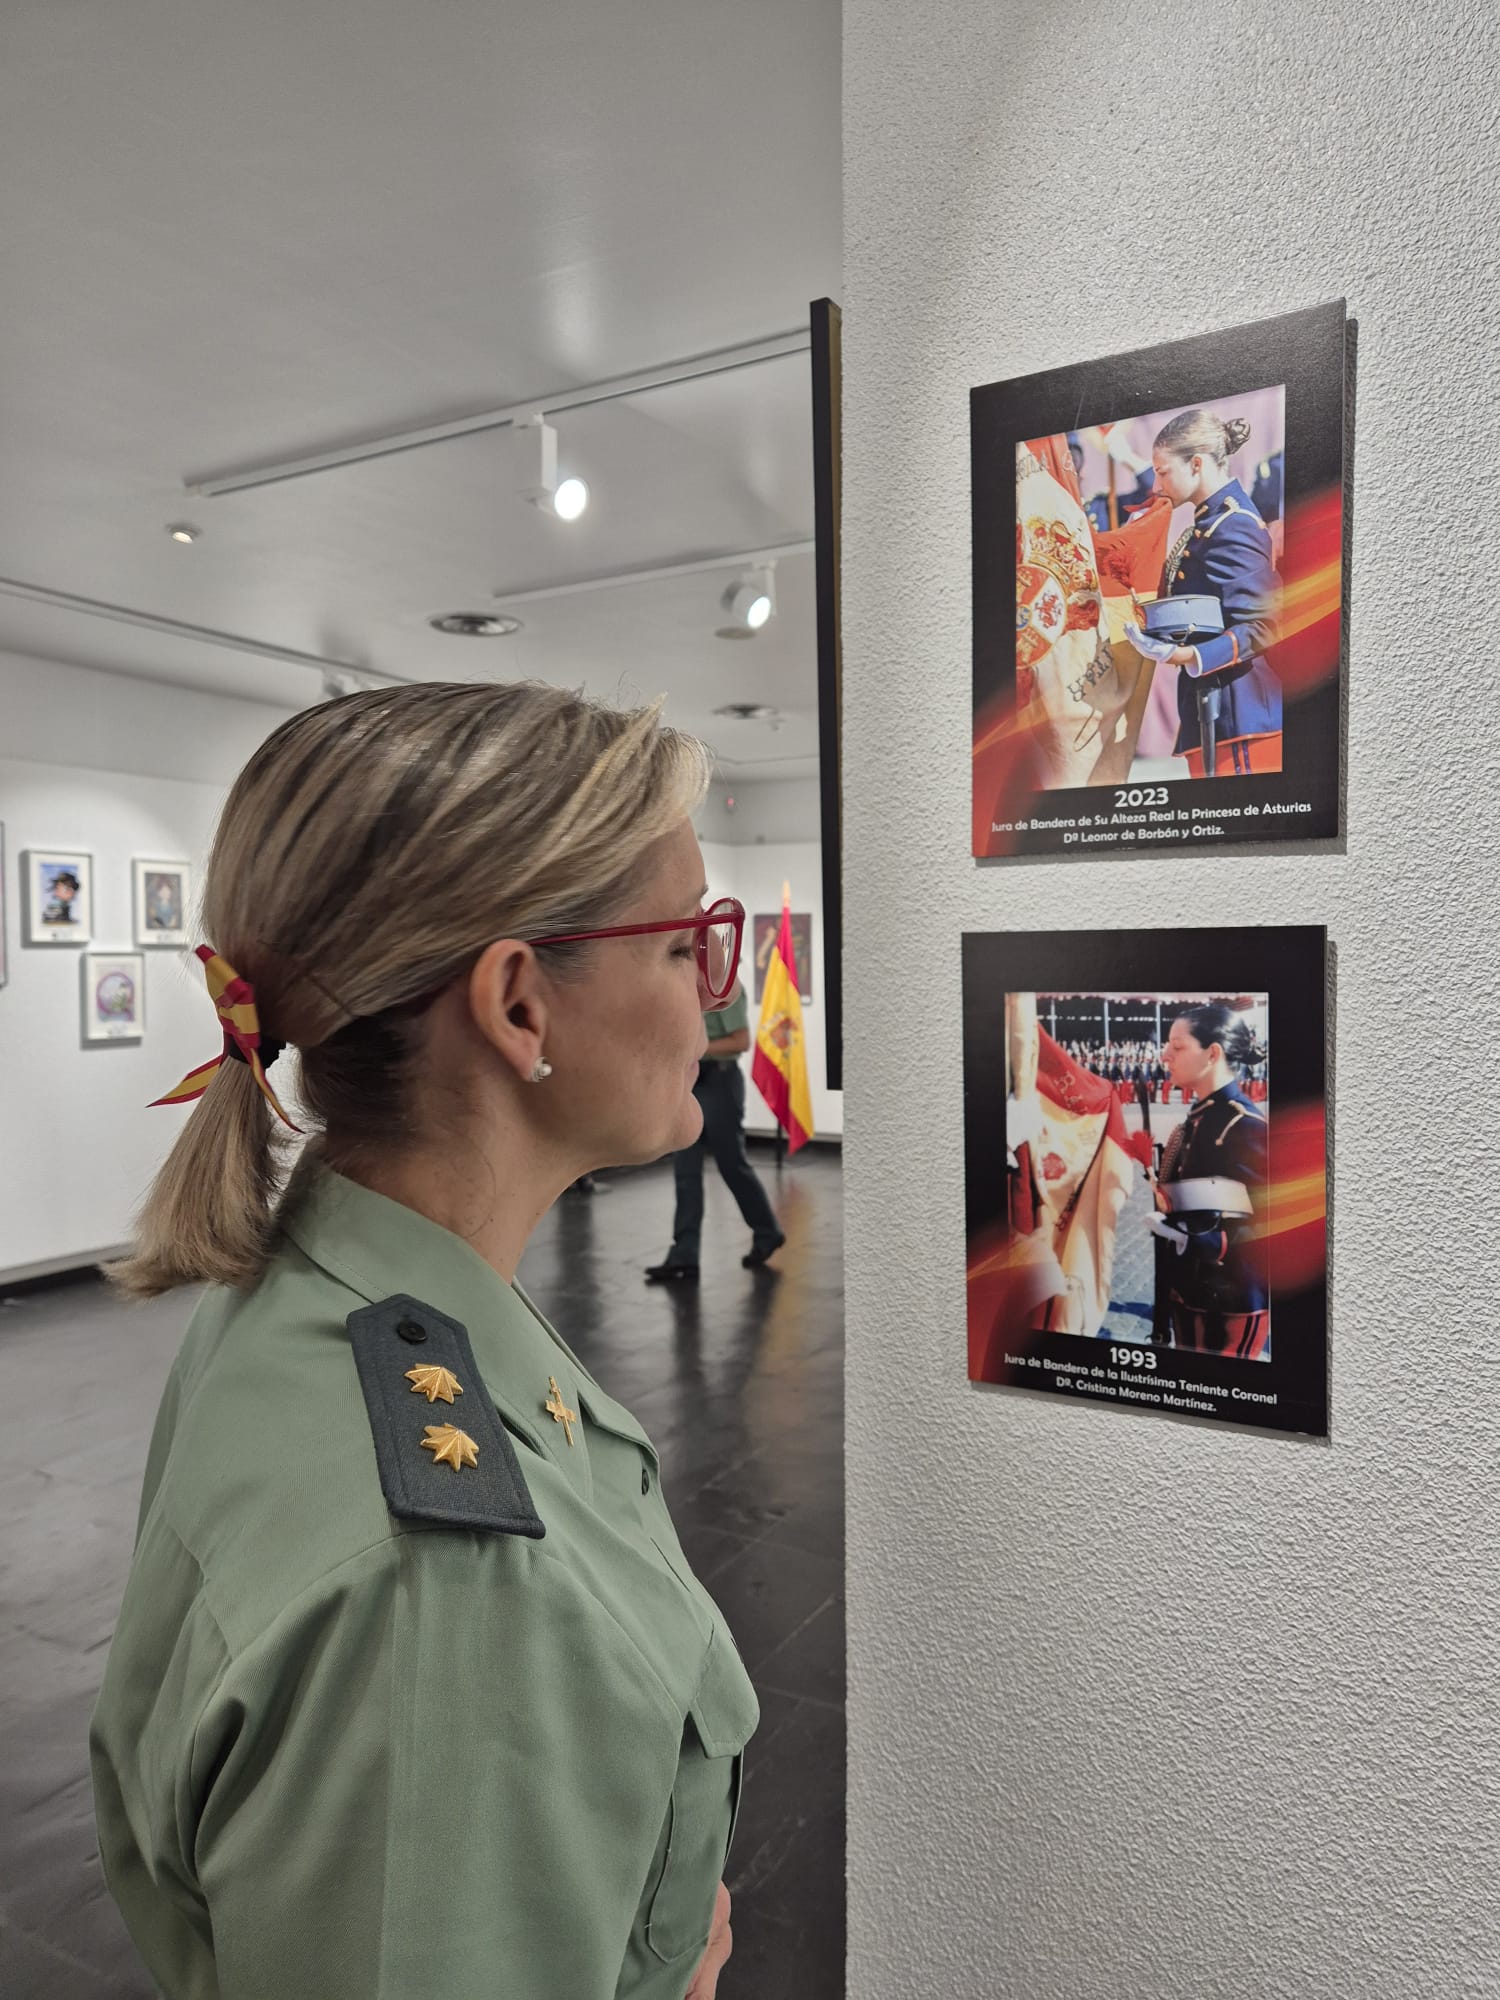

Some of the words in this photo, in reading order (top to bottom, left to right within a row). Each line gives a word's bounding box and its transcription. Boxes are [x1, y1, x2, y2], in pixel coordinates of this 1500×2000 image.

[1114, 787, 1169, 808] 2023
[1015, 820, 1028, 830] de
[1031, 817, 1076, 829] Bandera
[1078, 816, 1092, 827] de
[1095, 815, 1108, 825] Su
[1110, 813, 1147, 825] Alteza
[1150, 810, 1174, 822] Real
[1178, 810, 1189, 820] la
[1192, 806, 1241, 819] Princesa
[1244, 805, 1259, 816] de
[1262, 802, 1312, 815] Asturias
[1081, 830, 1118, 843] Leonor
[1121, 829, 1135, 840] de
[1138, 827, 1179, 840] Borbón
[1182, 829, 1189, 839] y
[1192, 825, 1224, 836] Ortiz.
[1110, 1346, 1157, 1369] 1993
[1027, 1357, 1042, 1368] de
[1043, 1359, 1089, 1375] Bandera
[1091, 1366, 1105, 1378] de
[1107, 1368, 1118, 1380] la
[1120, 1370, 1176, 1389] Ilustrísima
[1179, 1379, 1229, 1397] Teniente
[1231, 1387, 1277, 1405] Coronel
[1076, 1379, 1117, 1396] Cristina
[1119, 1386, 1161, 1403] Moreno
[1163, 1393, 1217, 1412] Martínez.
